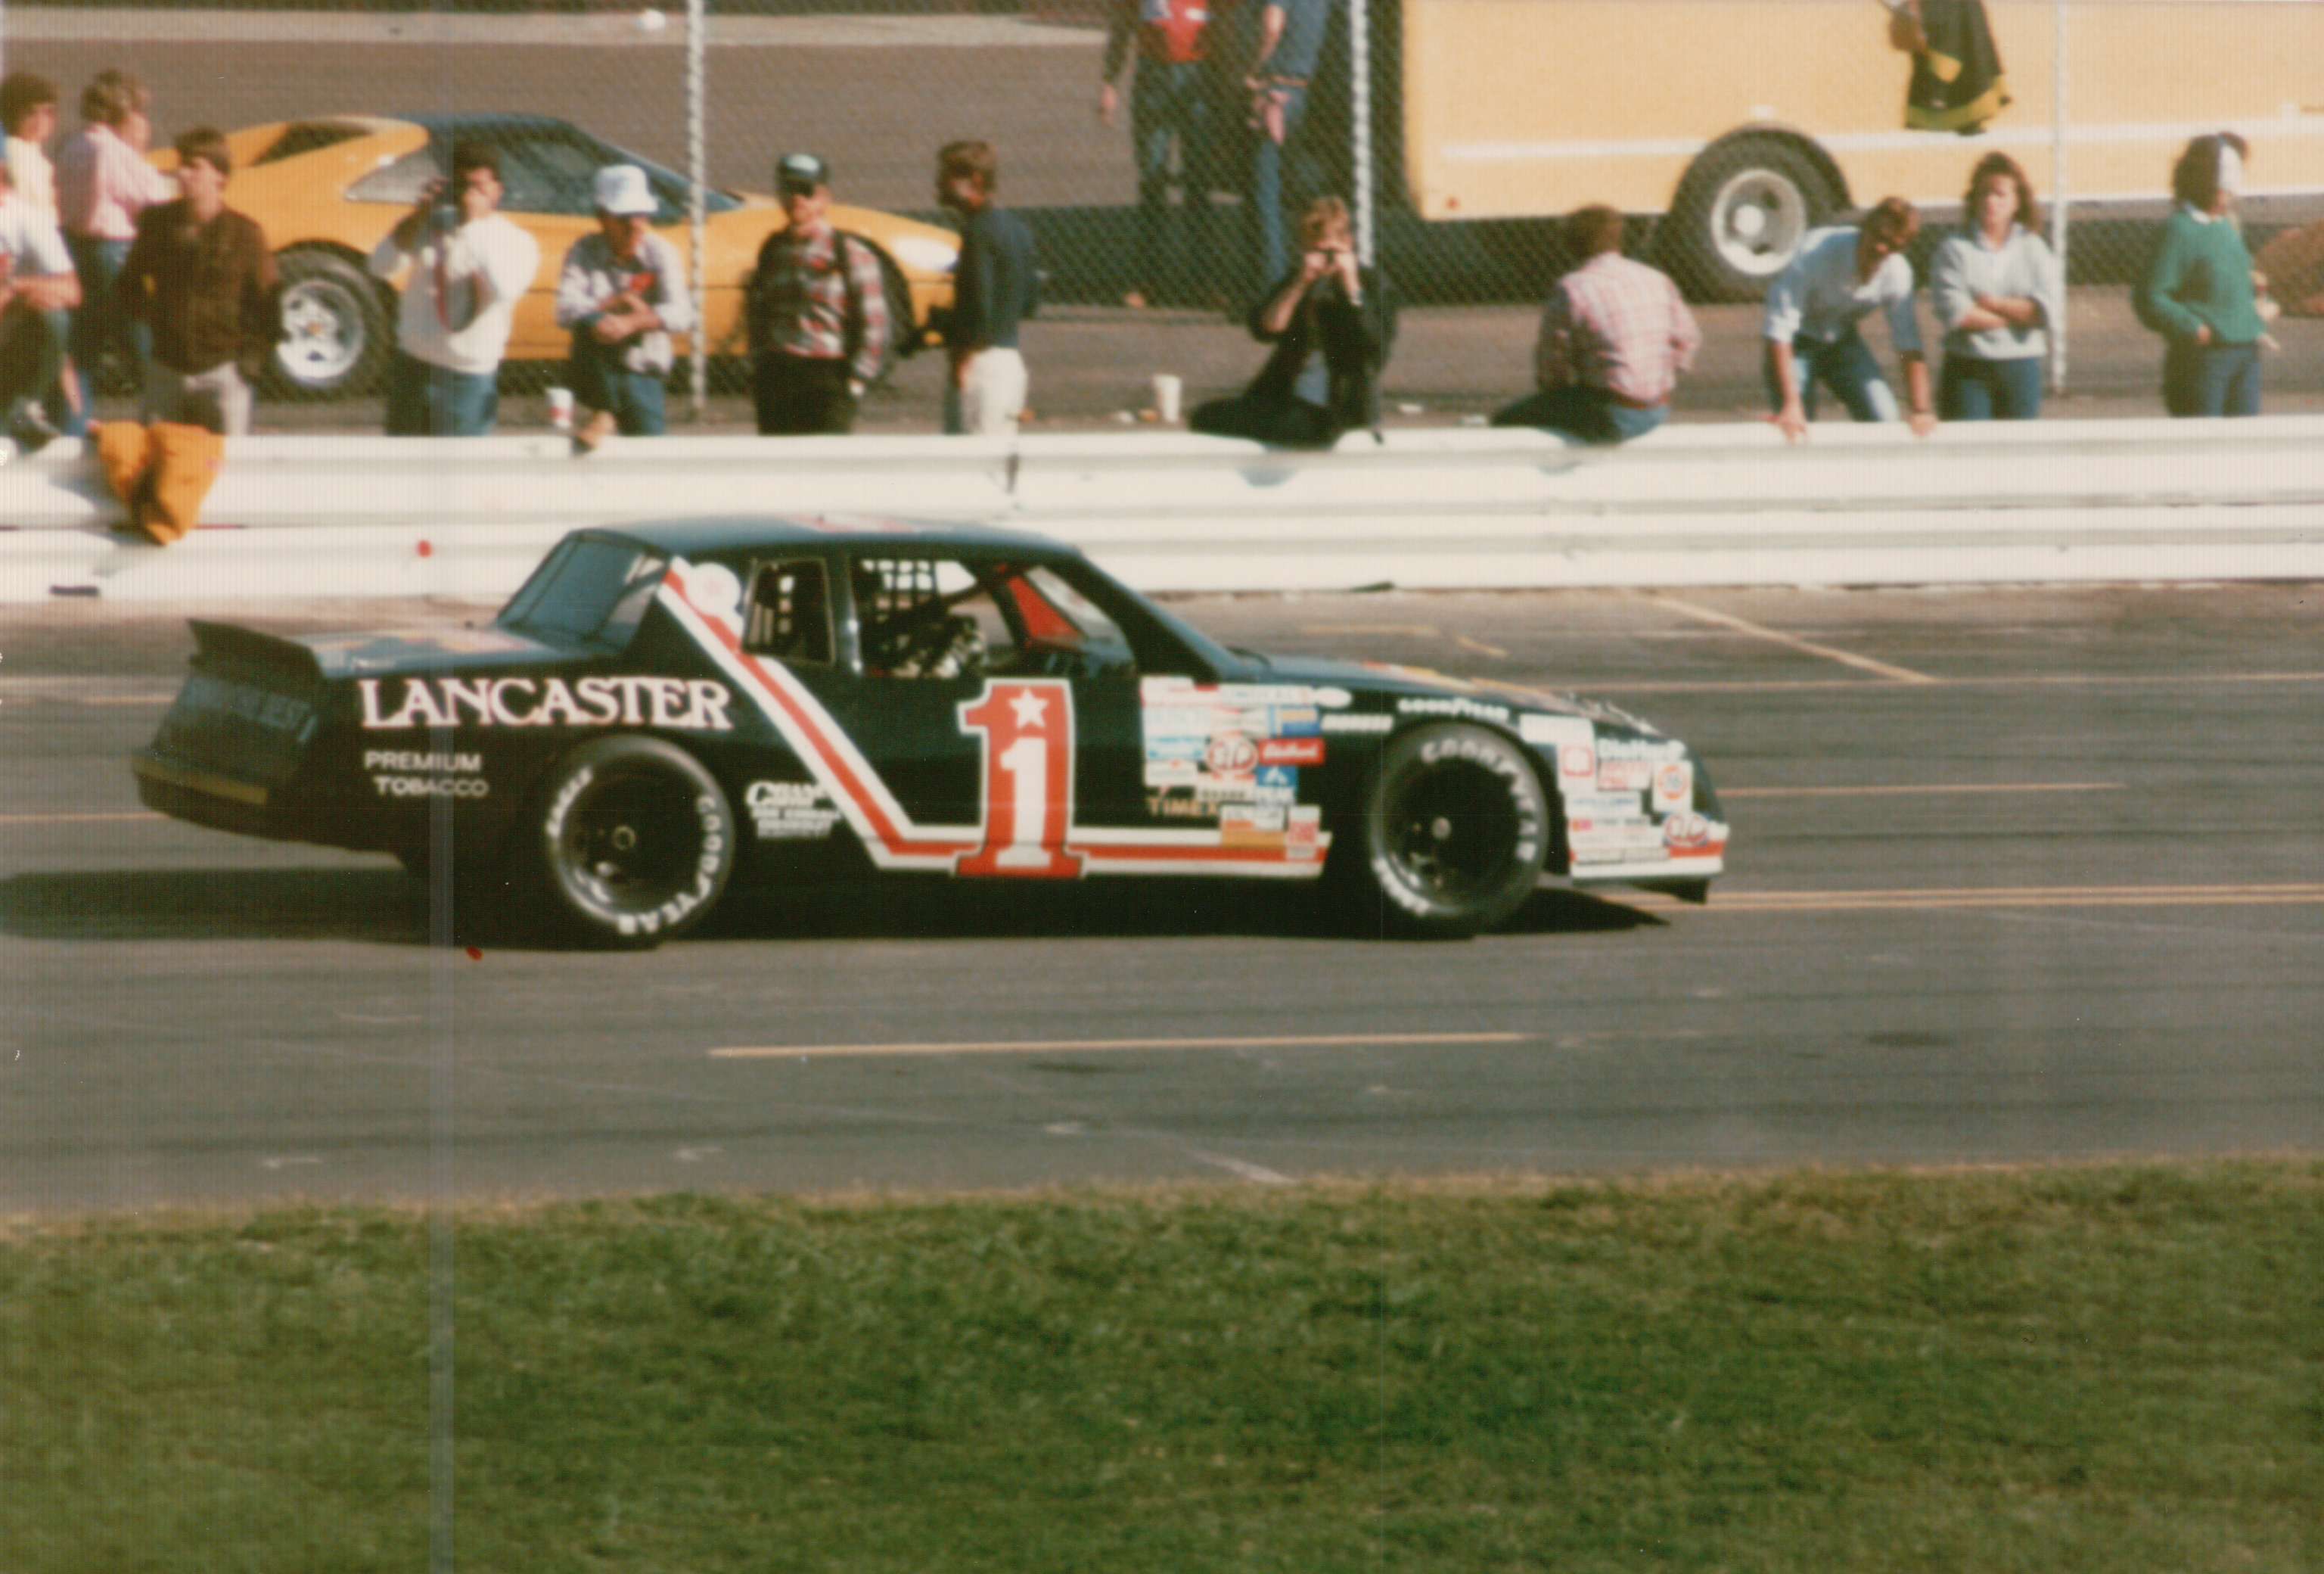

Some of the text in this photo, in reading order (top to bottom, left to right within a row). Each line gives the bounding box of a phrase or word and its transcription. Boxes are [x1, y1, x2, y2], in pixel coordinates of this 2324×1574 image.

[358, 675, 735, 729] LANCASTER
[364, 750, 482, 772] PREMIUM
[372, 775, 490, 798] TOBACCO
[956, 677, 1087, 879] 1
[617, 795, 723, 935] GOODYEAR
